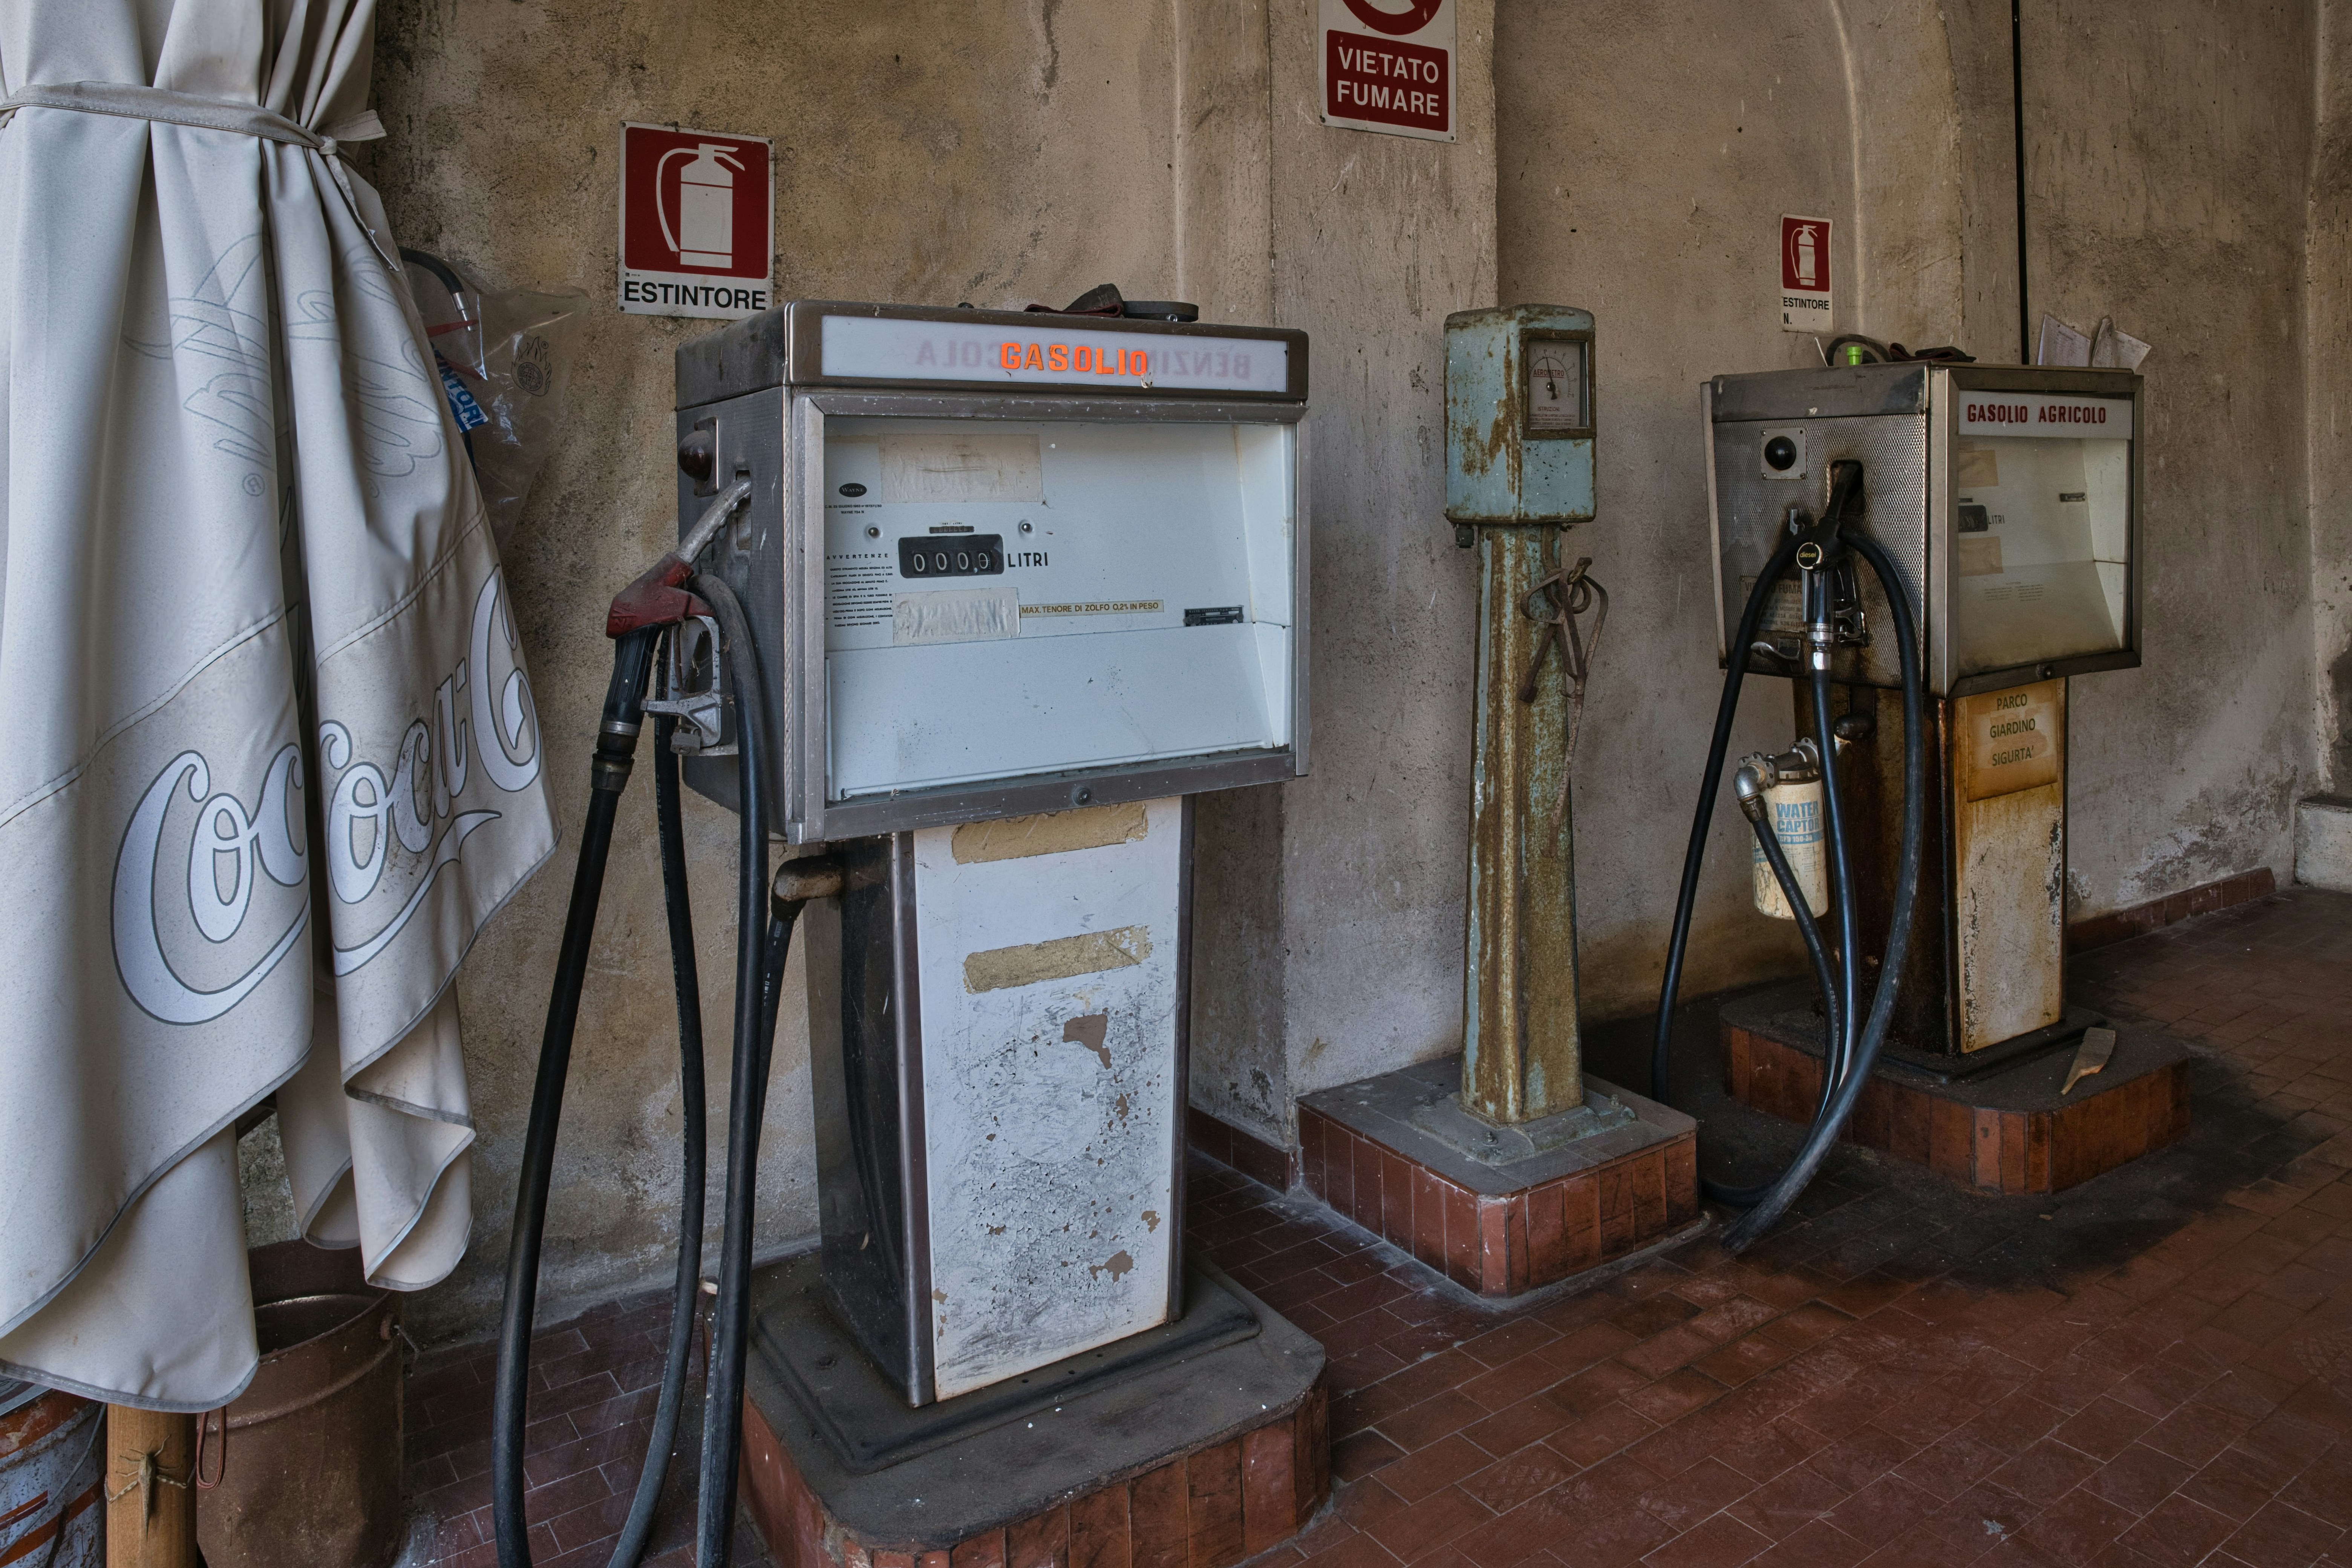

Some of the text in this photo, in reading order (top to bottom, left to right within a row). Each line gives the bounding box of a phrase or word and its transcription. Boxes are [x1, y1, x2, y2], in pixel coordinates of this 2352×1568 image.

[1338, 46, 1439, 83] VIETATO
[1338, 80, 1439, 116] FUMARE
[624, 281, 766, 310] ESTINTORE
[1783, 297, 1829, 310] ESTINTORE
[1783, 312, 1792, 325] N.
[1001, 342, 1147, 376] GASOLIO
[1967, 404, 2106, 424] GASOLIO AGRICOLO
[1988, 514, 2005, 525] LITRI
[1008, 552, 1048, 568] LITRI
[1042, 605, 1072, 613] TENORE
[1085, 603, 1110, 611] ZOLFO
[1112, 603, 1129, 611] 0,2%
[1997, 694, 2027, 711] PARCO
[1990, 718, 2035, 738] GIARDINO
[1776, 801, 1819, 818] WATER
[1777, 817, 1819, 833] CAPTOR
